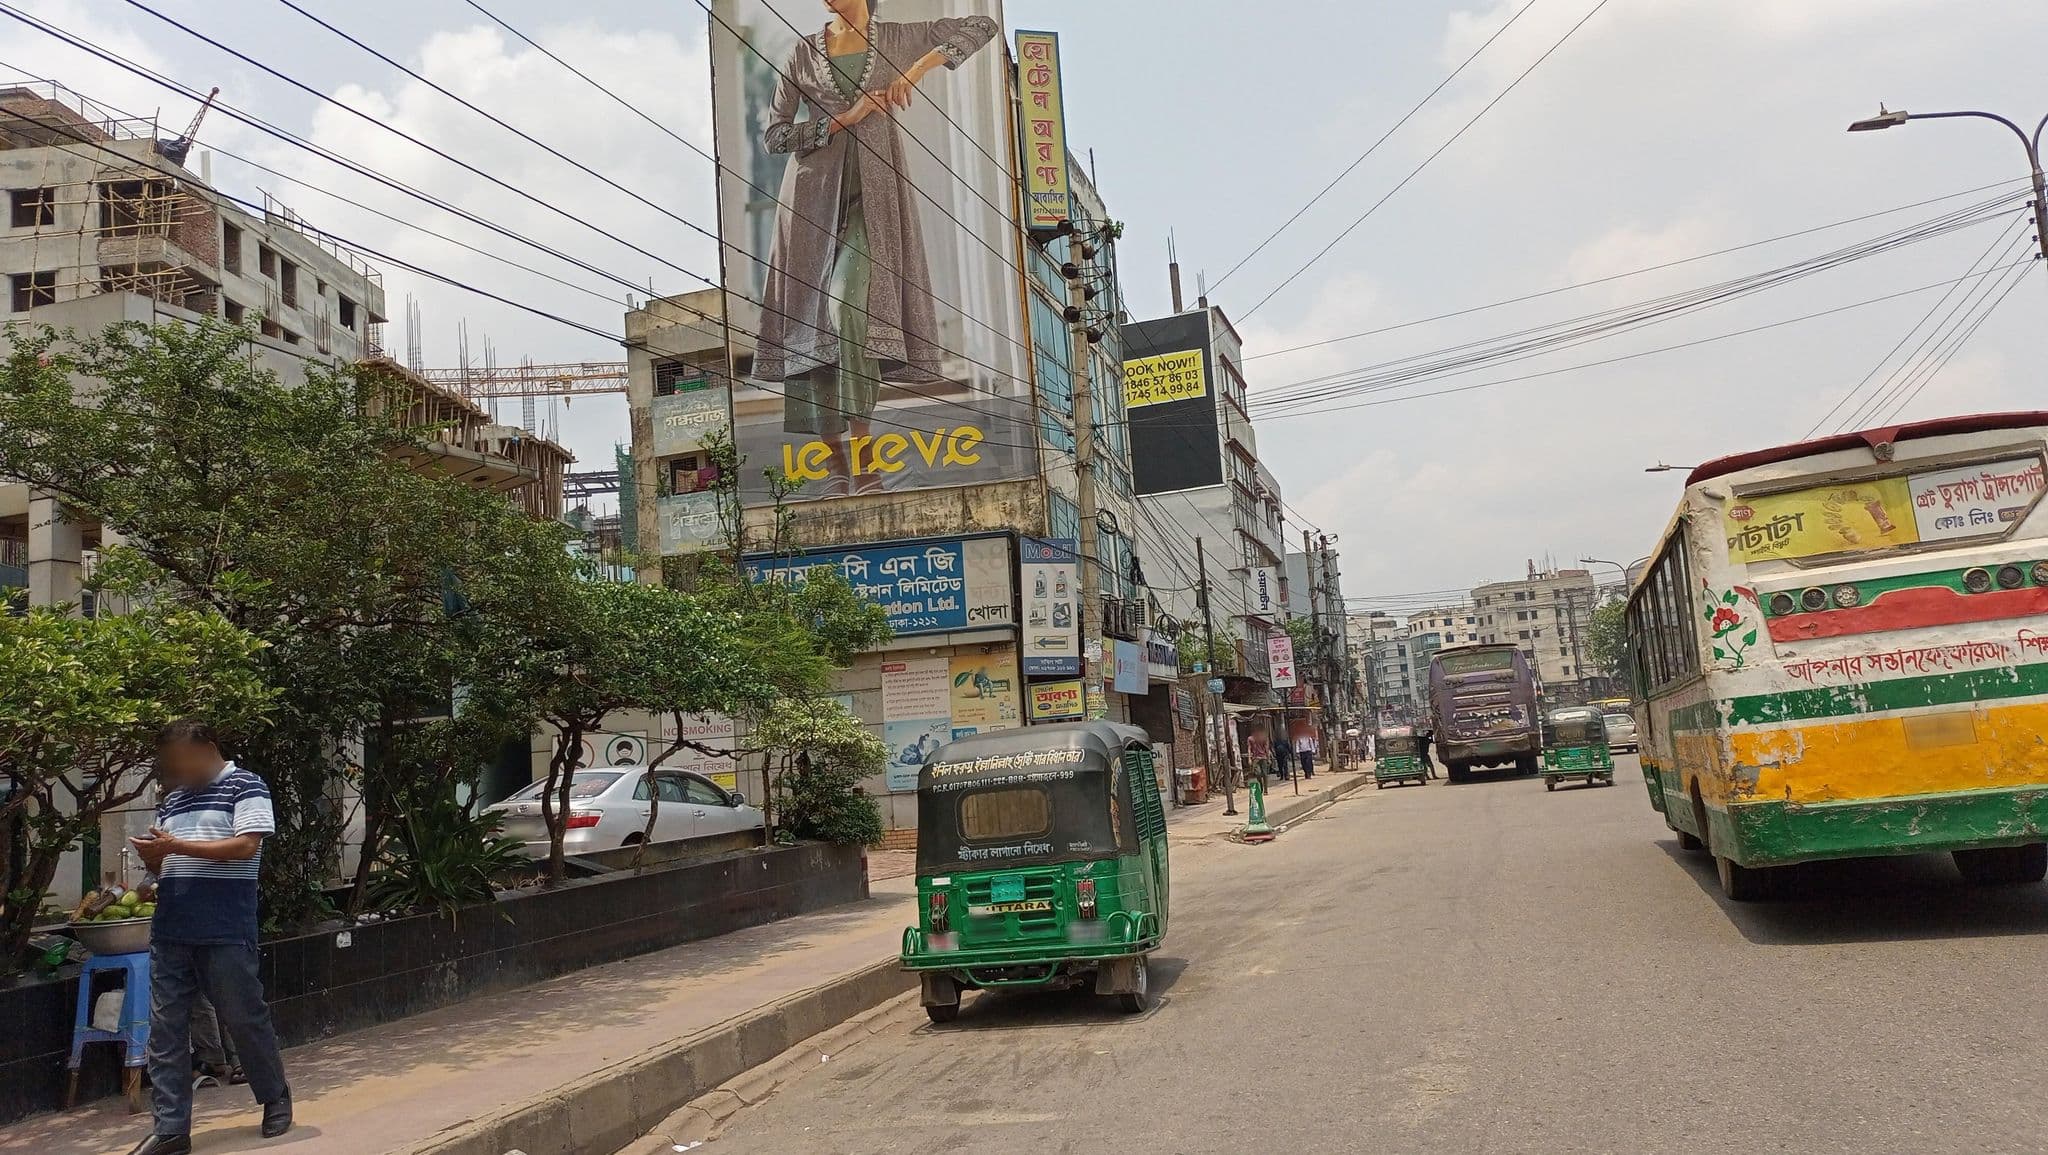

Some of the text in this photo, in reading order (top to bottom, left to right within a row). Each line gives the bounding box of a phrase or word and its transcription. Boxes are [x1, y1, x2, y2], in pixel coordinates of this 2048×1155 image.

[1126, 356, 1196, 377] OOK NOW!!
[1153, 376, 1165, 385] 57
[1169, 372, 1182, 382] 86
[1185, 370, 1198, 380] 03
[1155, 387, 1166, 396] 14
[1170, 383, 1183, 394] 99
[1186, 381, 1199, 391] 84
[850, 426, 984, 476] reve
[1025, 541, 1072, 559] Mobil
[924, 547, 957, 574] জি
[898, 576, 963, 598] লিমিটেড
[928, 596, 959, 612] Ltd.
[968, 602, 1008, 620] খোলা
[683, 724, 731, 735] SMOKING
